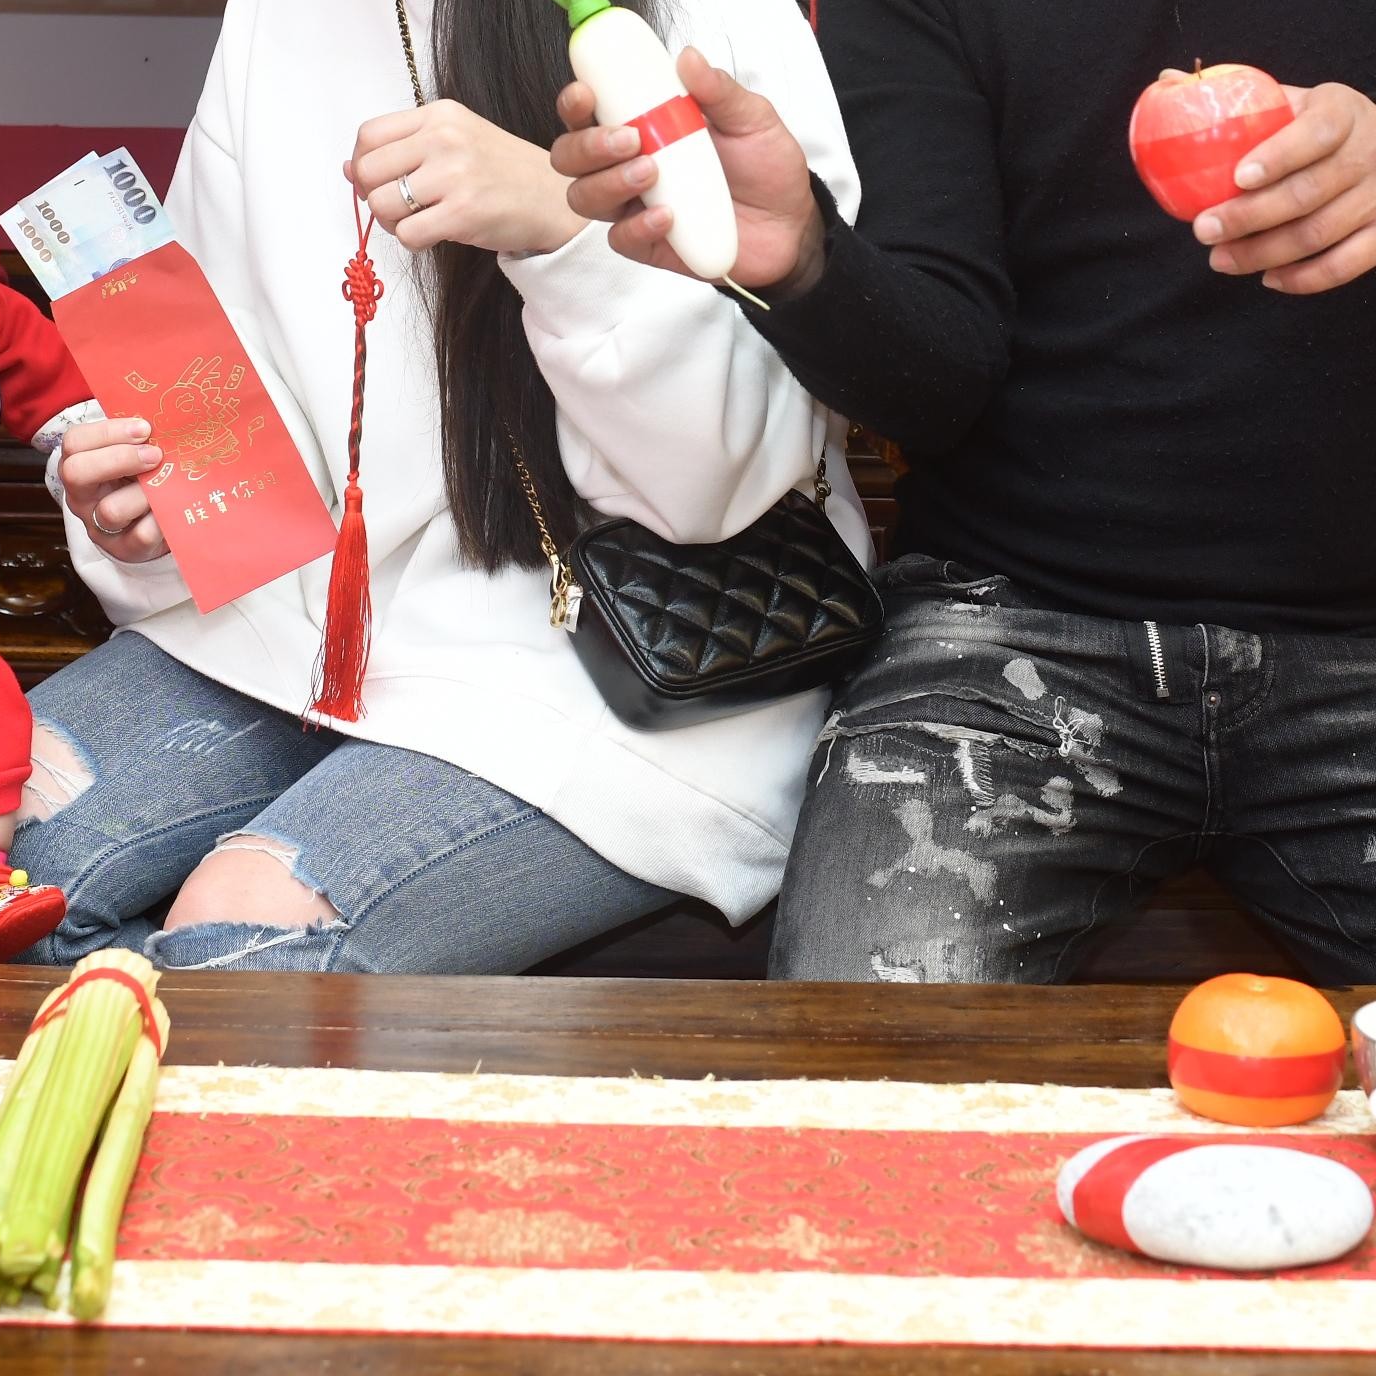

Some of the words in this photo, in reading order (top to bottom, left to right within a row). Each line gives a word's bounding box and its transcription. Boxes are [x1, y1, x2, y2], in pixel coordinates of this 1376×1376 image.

[103, 159, 156, 224] 1000
[17, 217, 53, 263] 1000
[35, 200, 71, 244] 1000
